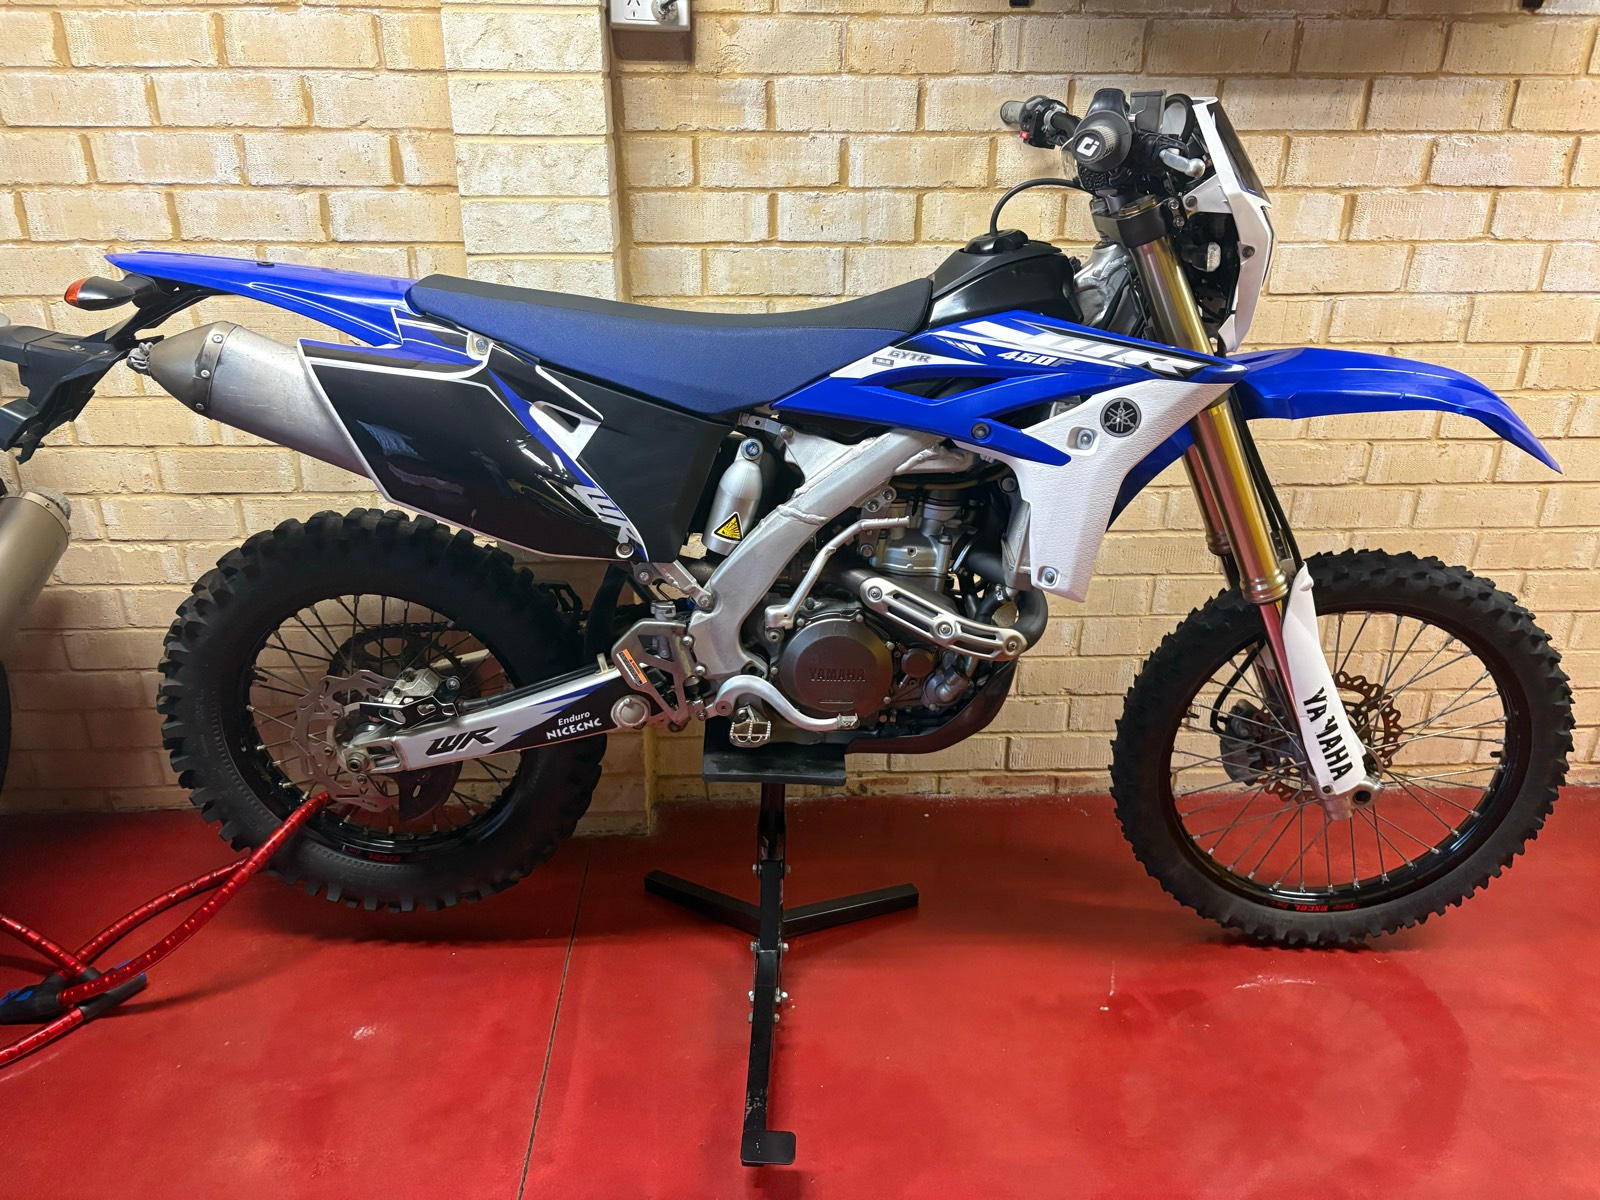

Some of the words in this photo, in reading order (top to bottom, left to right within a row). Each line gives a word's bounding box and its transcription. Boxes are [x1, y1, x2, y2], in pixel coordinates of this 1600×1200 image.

[888, 350, 932, 363] GYTR
[808, 667, 867, 682] YAMAHA
[558, 711, 591, 726] Enduro
[546, 717, 603, 740] NICECNC
[425, 725, 500, 758] WR
